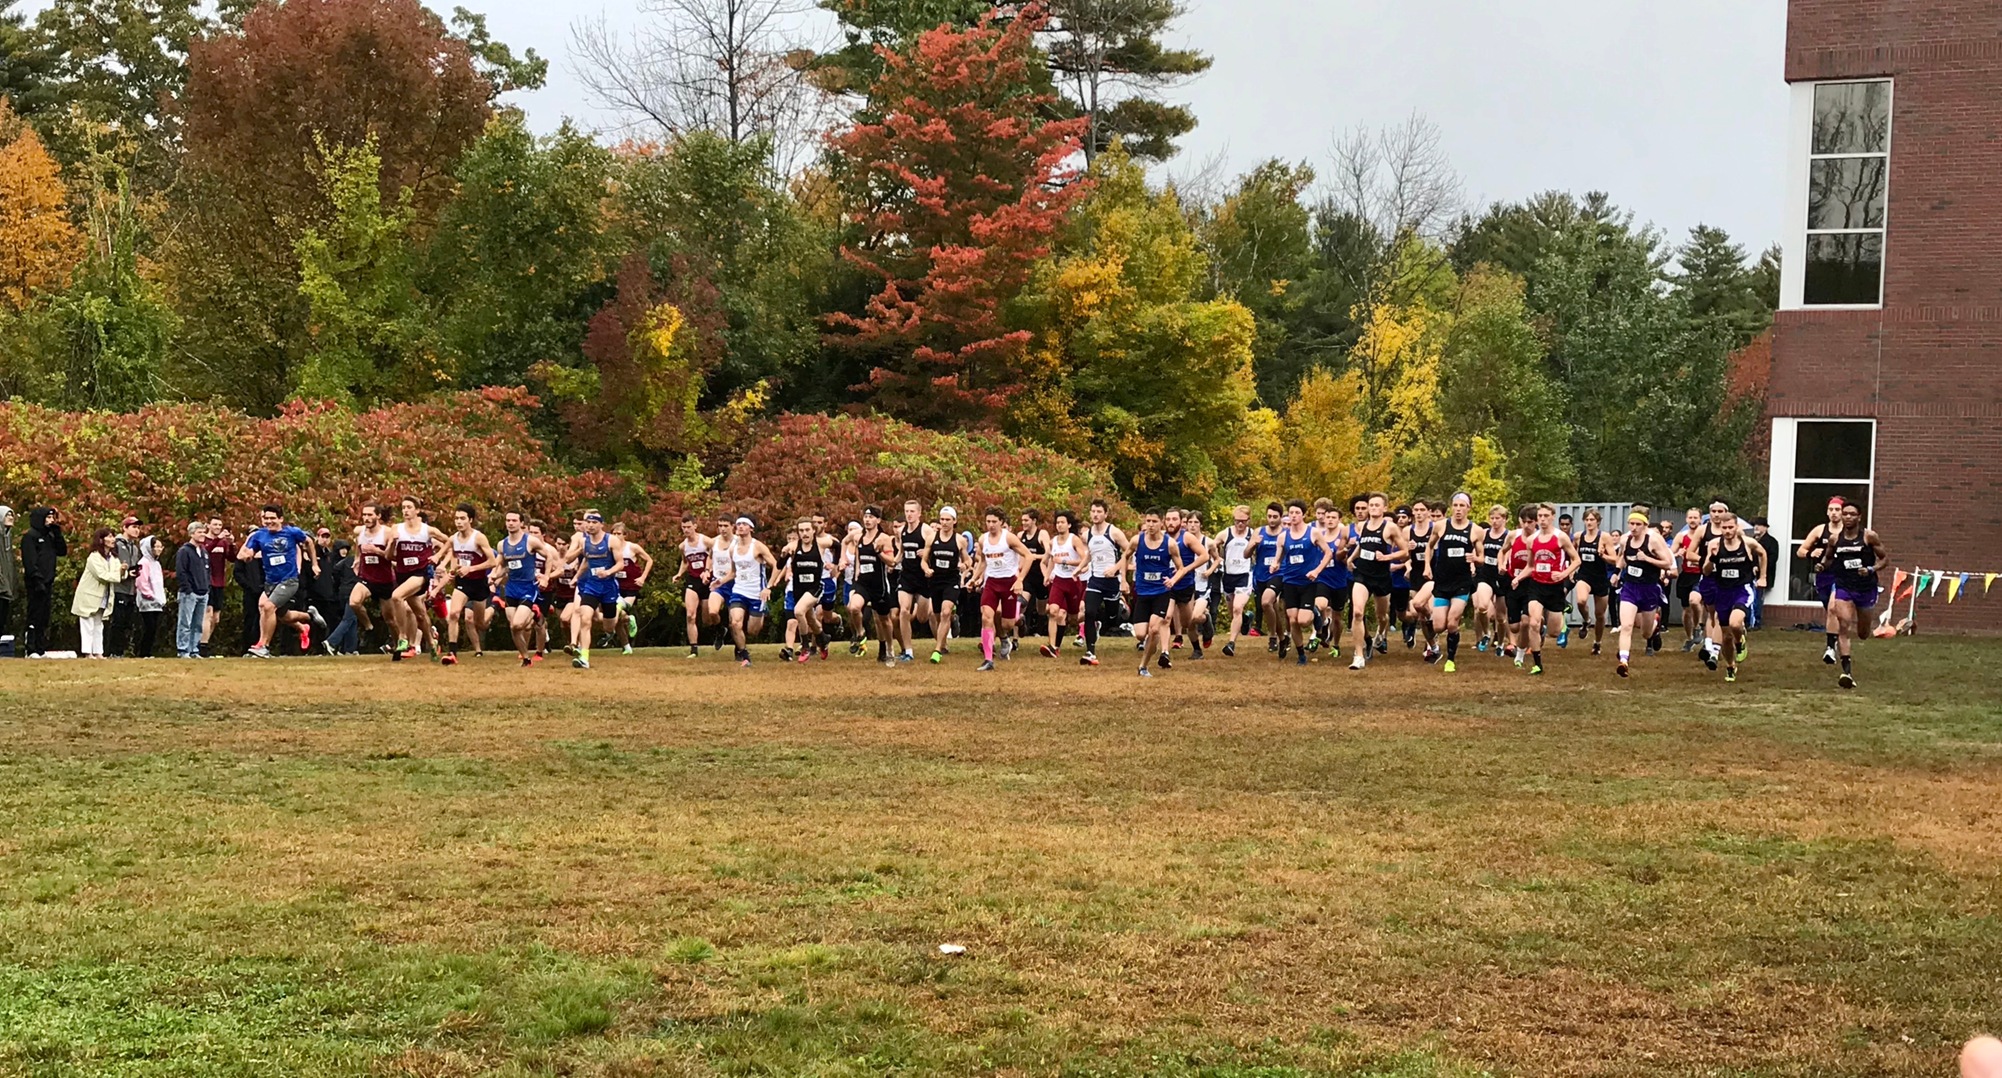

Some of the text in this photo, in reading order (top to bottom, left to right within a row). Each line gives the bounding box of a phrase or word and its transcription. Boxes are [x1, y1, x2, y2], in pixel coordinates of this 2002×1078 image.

[1360, 536, 1382, 544] UNE
[1444, 534, 1468, 545] UNE
[401, 543, 424, 552] BATES
